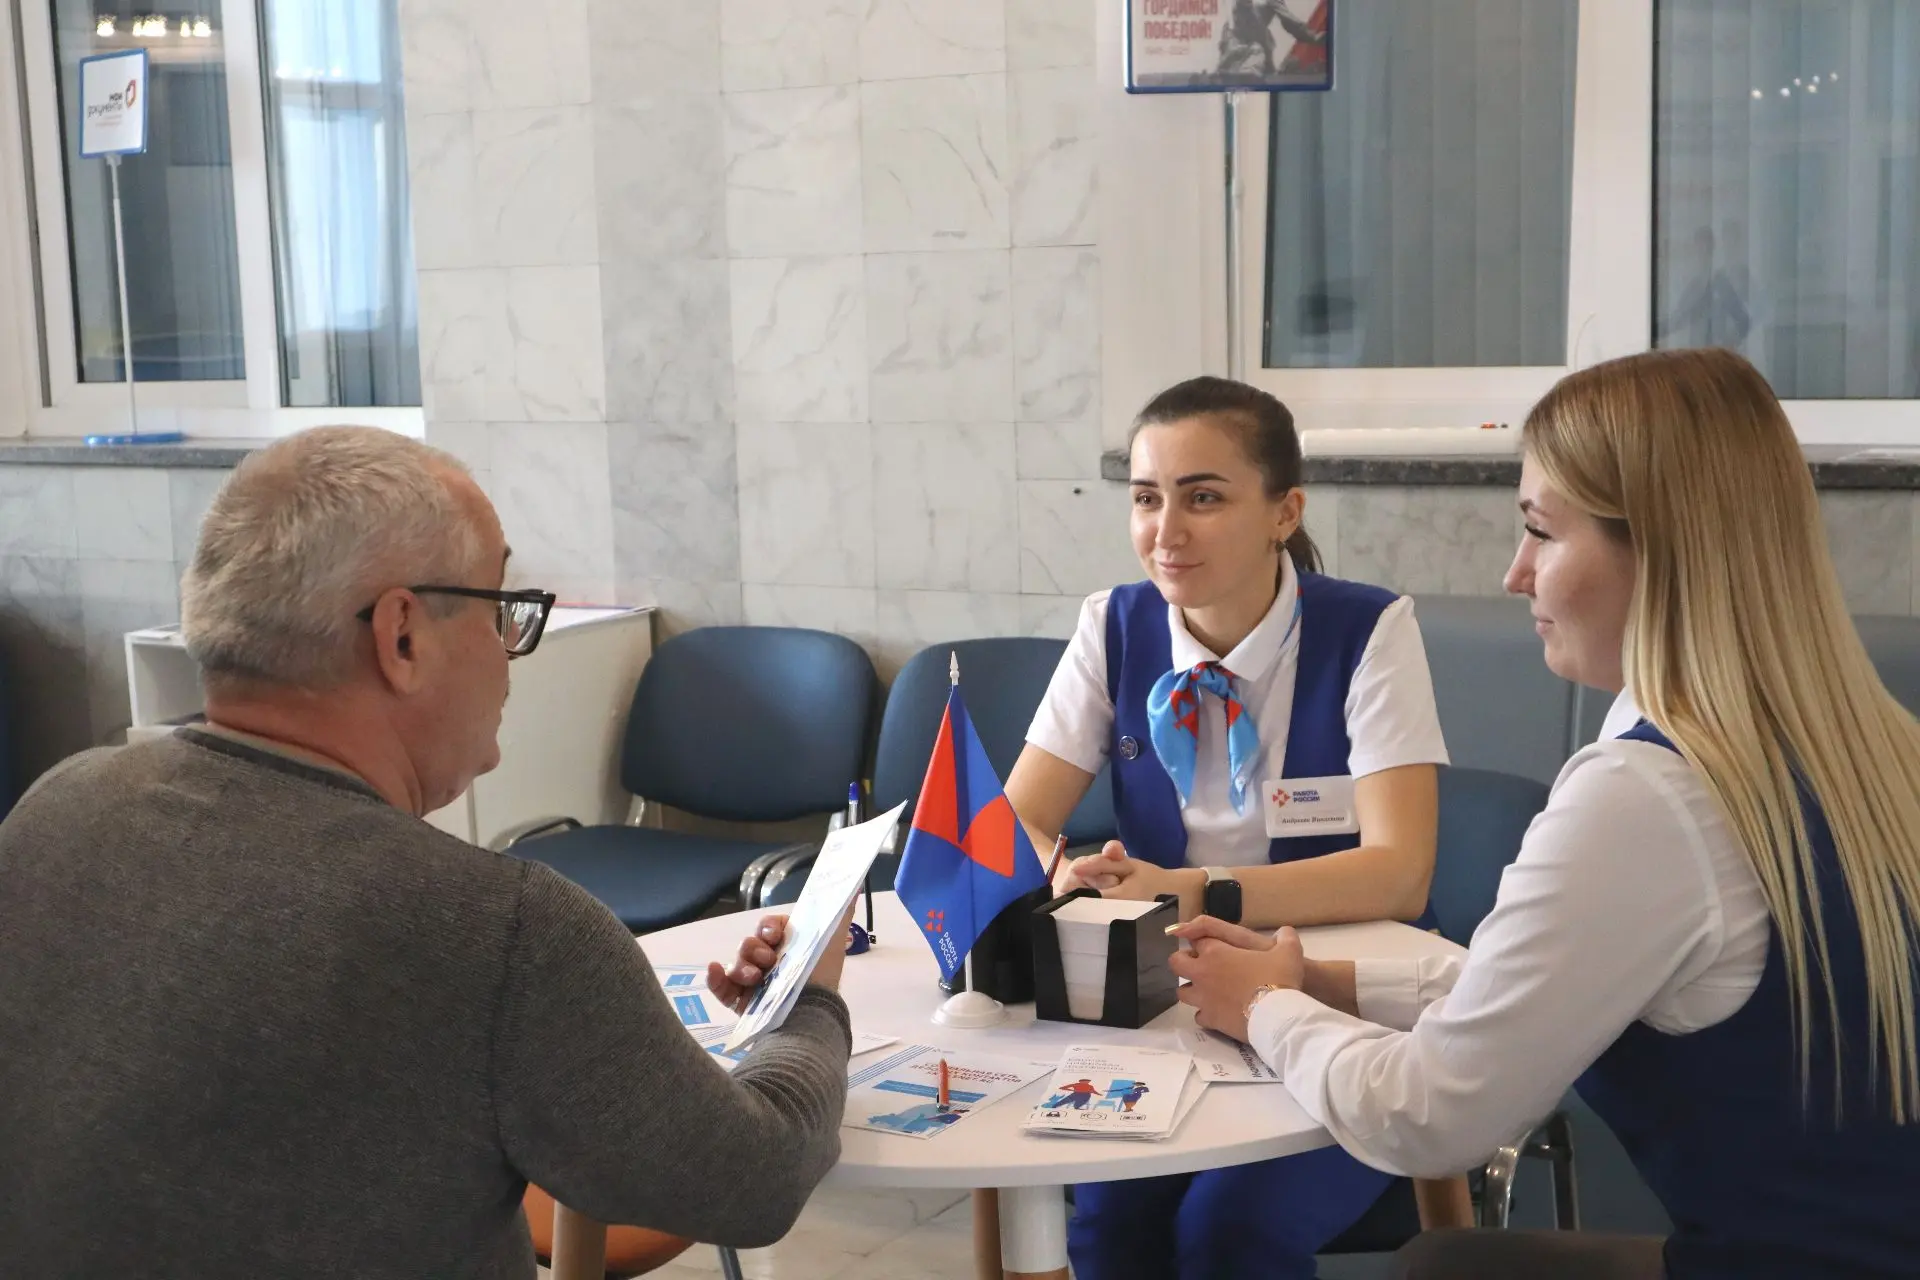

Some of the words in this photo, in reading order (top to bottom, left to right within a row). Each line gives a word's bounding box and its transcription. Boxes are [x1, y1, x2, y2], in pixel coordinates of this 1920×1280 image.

[1144, 20, 1212, 41] ПОБЕДОЙ!
[939, 938, 955, 971] РОССИИ
[943, 931, 958, 962] РАБОТА
